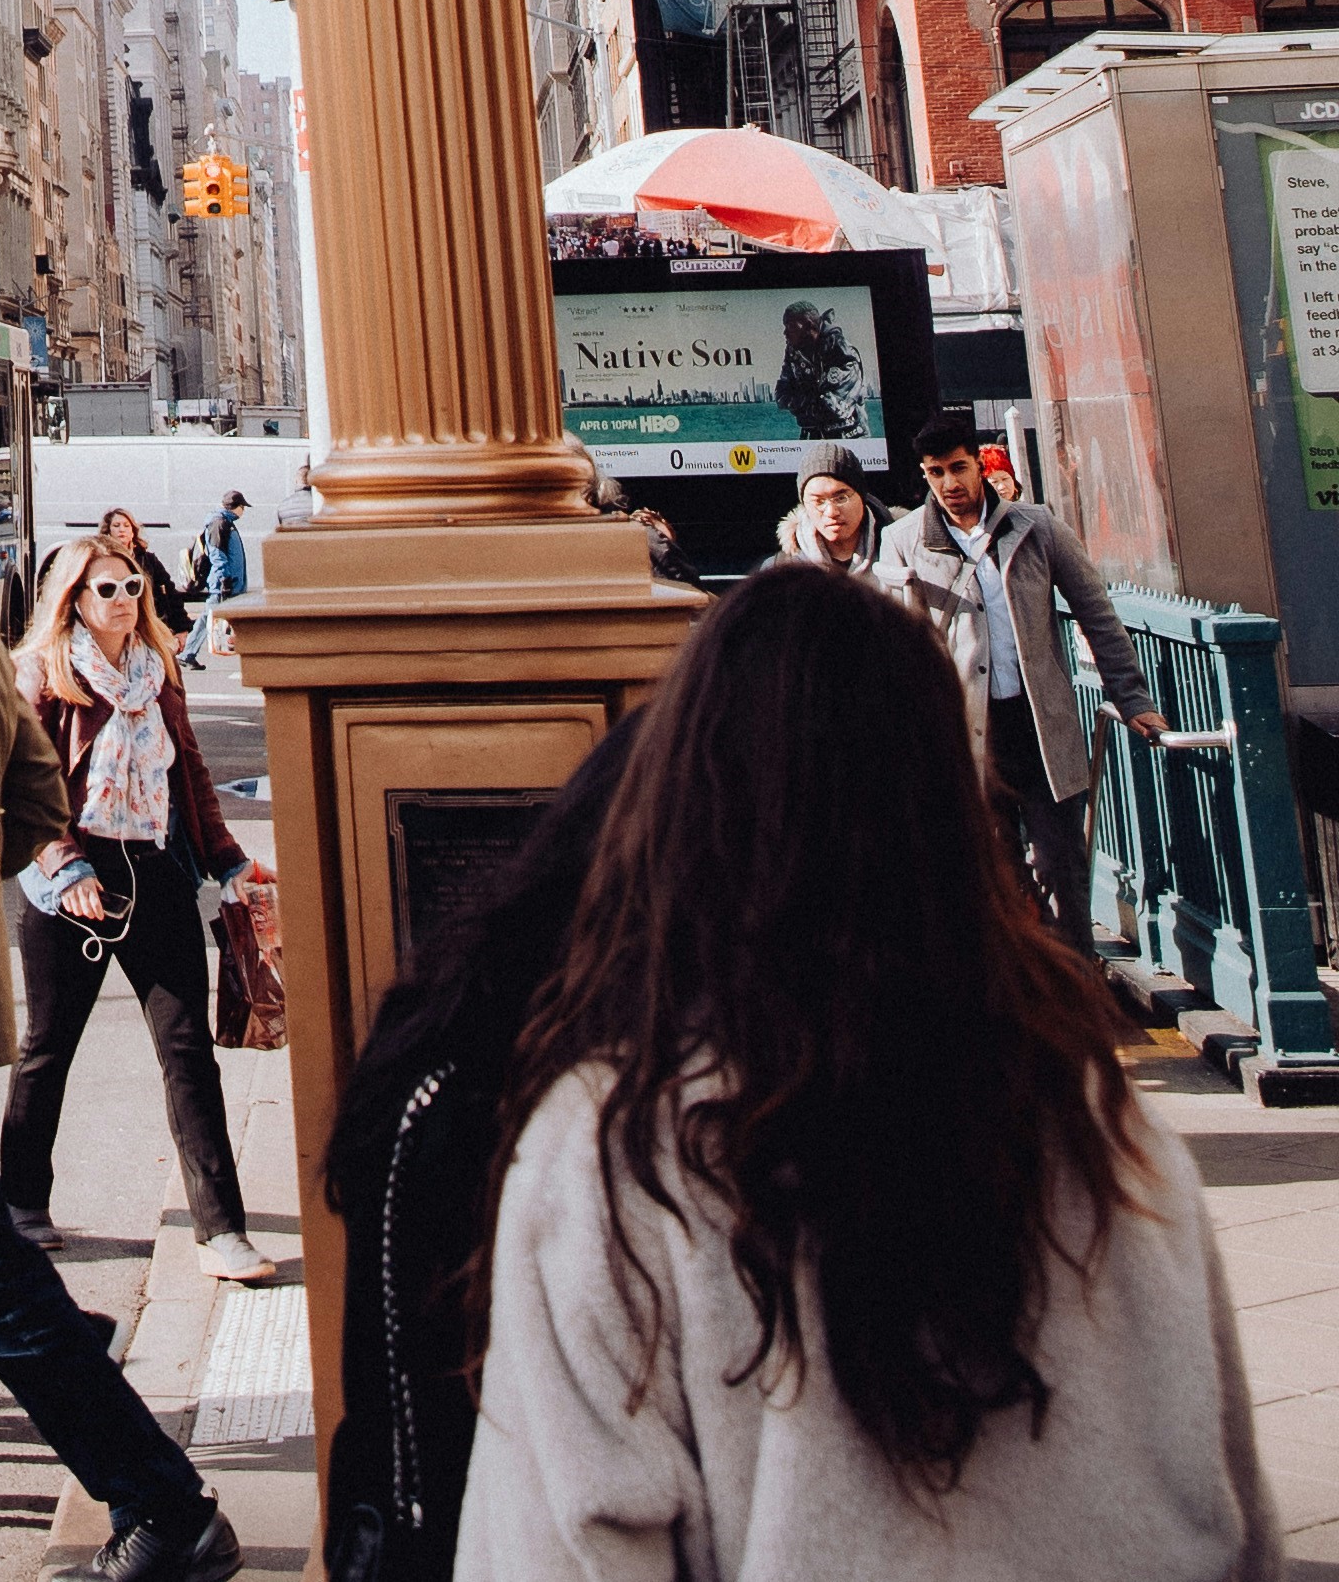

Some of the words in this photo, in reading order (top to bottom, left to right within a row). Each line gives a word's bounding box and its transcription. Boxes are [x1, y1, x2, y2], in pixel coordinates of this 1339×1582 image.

[1287, 176, 1330, 189] Steve,
[1291, 207, 1318, 219] The
[1321, 206, 1339, 218] de
[1297, 245, 1321, 256] say
[673, 259, 741, 272] OUTFRONT
[1299, 261, 1312, 272] in
[1315, 260, 1337, 272] the
[1304, 291, 1309, 303] I
[1311, 291, 1335, 303] left
[1309, 327, 1331, 339] the
[573, 339, 684, 370] Native
[691, 338, 754, 368] Son
[1312, 346, 1326, 357] at
[579, 419, 602, 432] APR
[602, 419, 609, 431] 6
[610, 418, 637, 431] 10PM
[639, 414, 680, 433] HBO
[595, 449, 640, 458] Downtown
[757, 444, 802, 454] Downtown
[1309, 446, 1335, 457] Stop
[670, 449, 683, 470] 0
[684, 460, 724, 470] minutes
[733, 450, 751, 466] W
